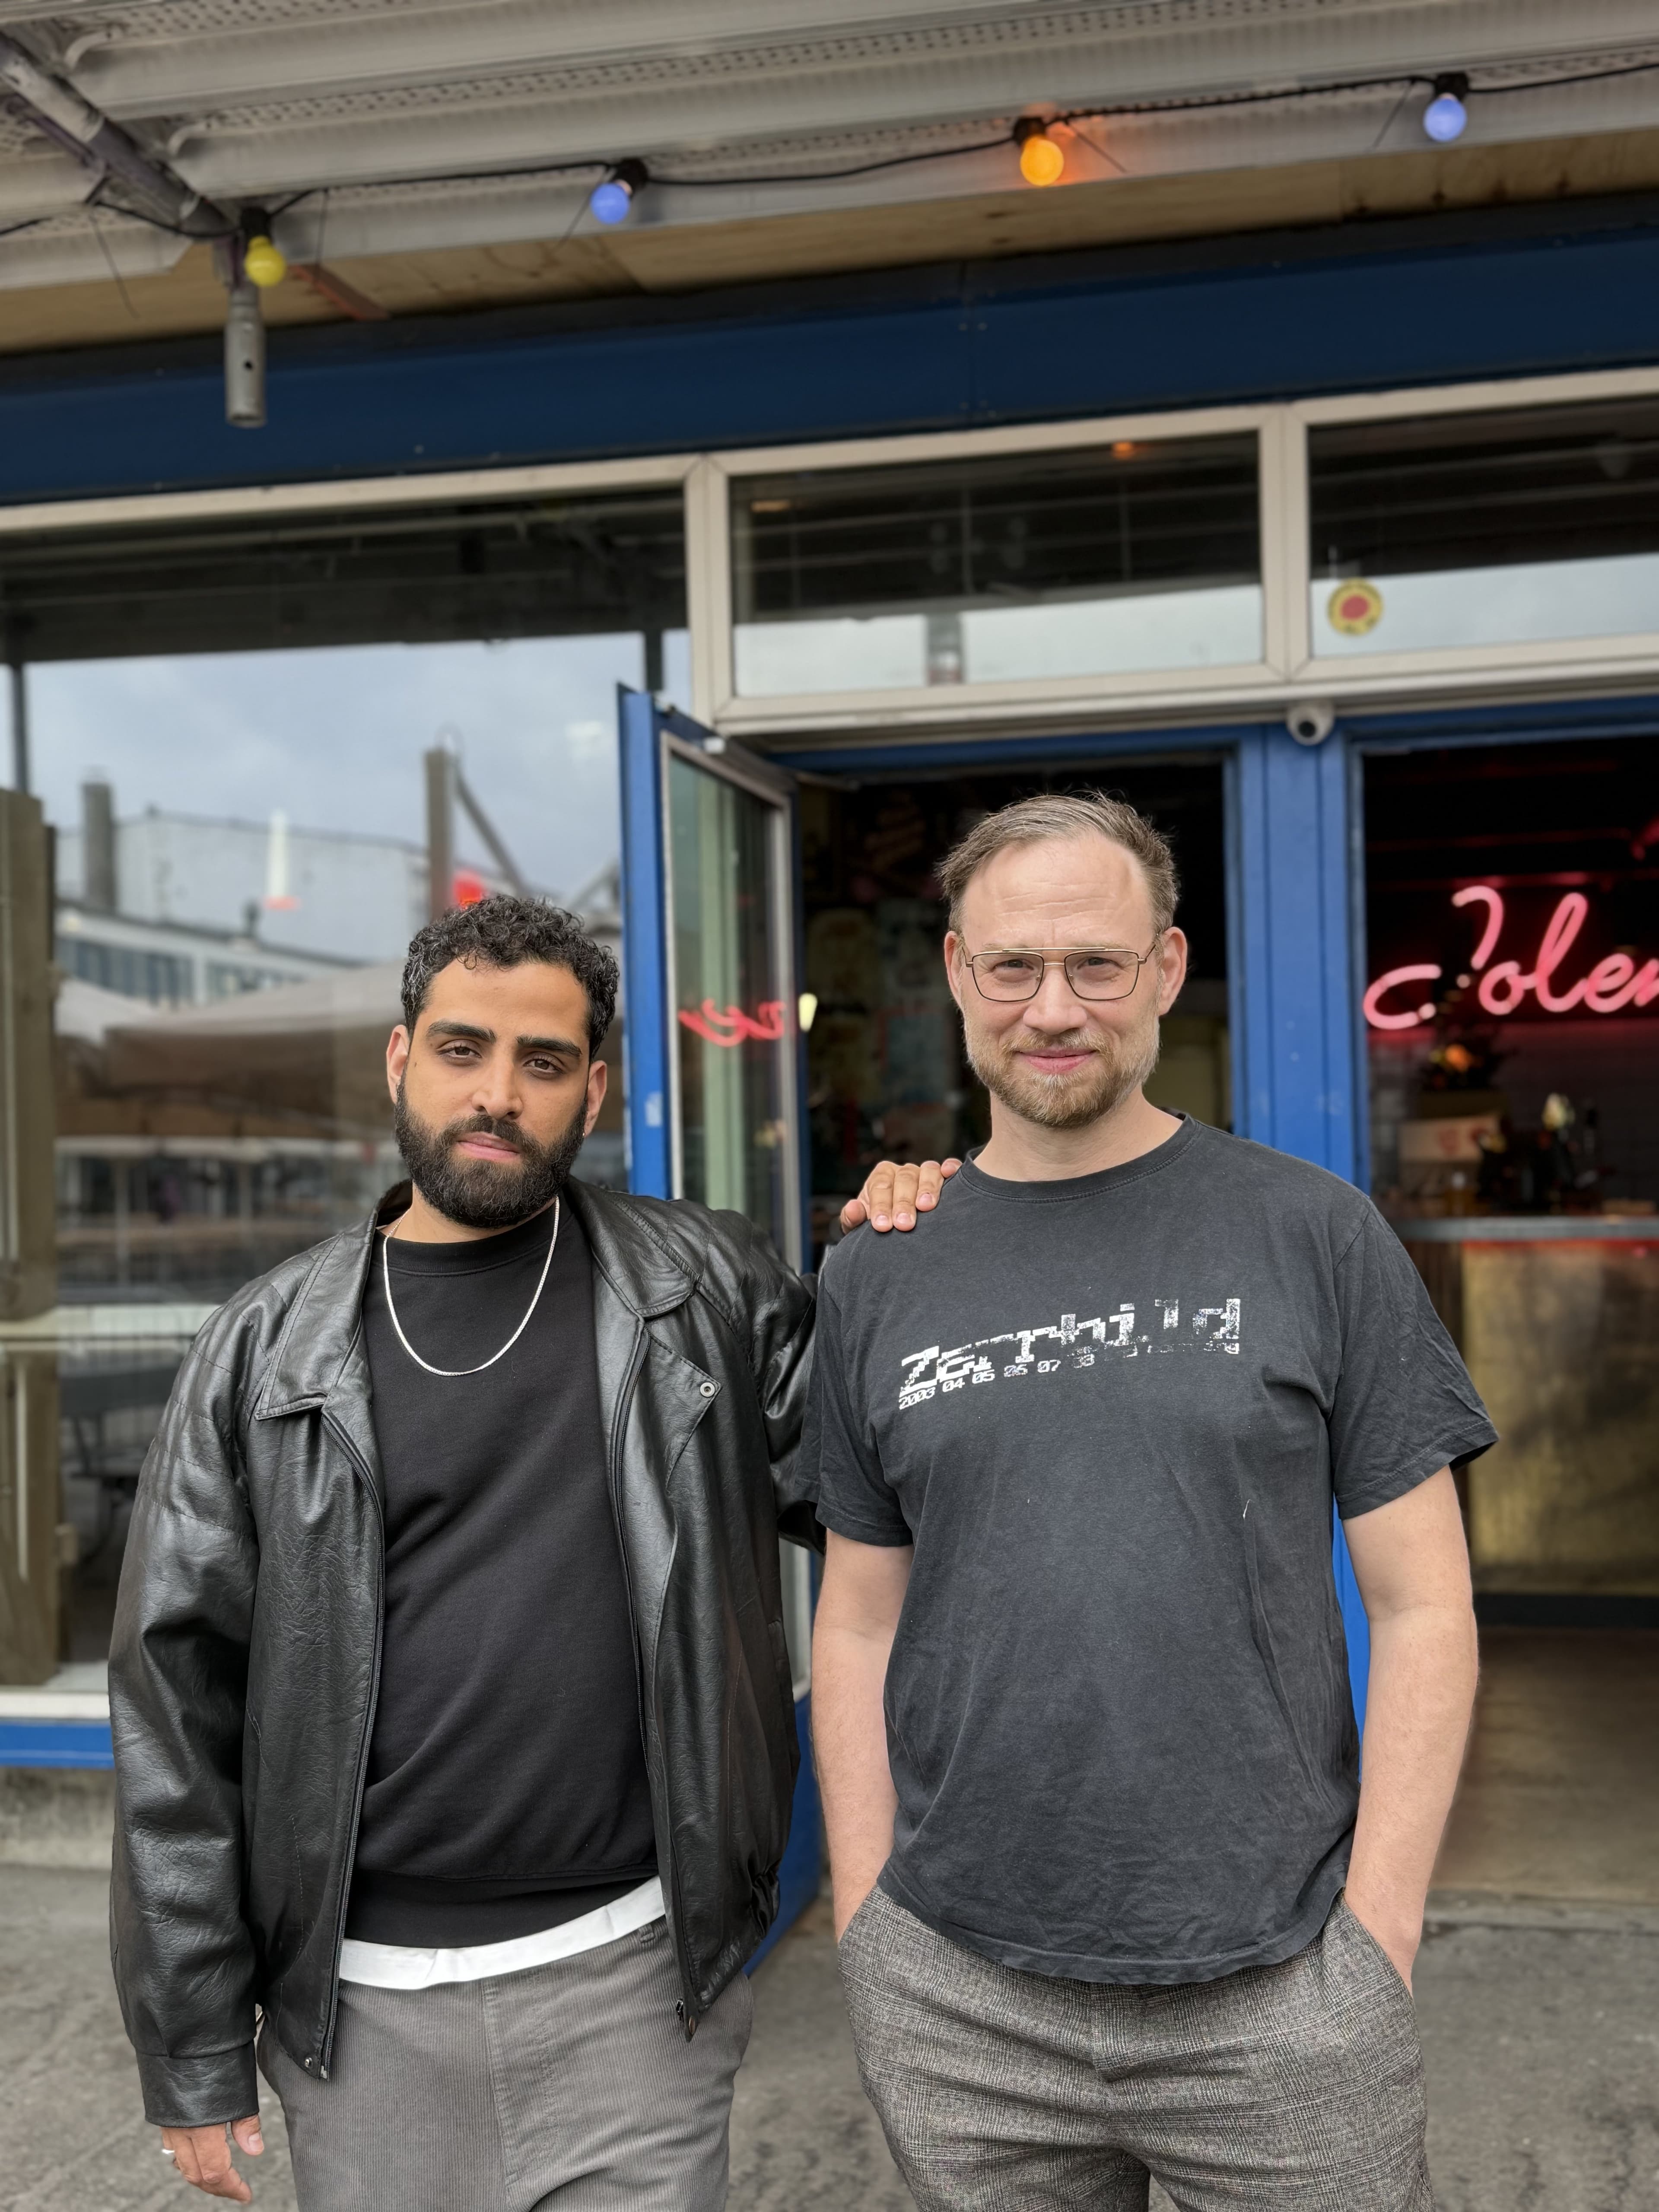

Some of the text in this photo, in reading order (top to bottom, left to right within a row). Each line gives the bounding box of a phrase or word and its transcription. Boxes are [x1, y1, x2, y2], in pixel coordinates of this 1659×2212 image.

[899, 1387, 936, 1410] 2003
[942, 1377, 965, 1392] 04
[972, 1369, 995, 1384] 05
[1037, 1359, 1062, 1373] 07
